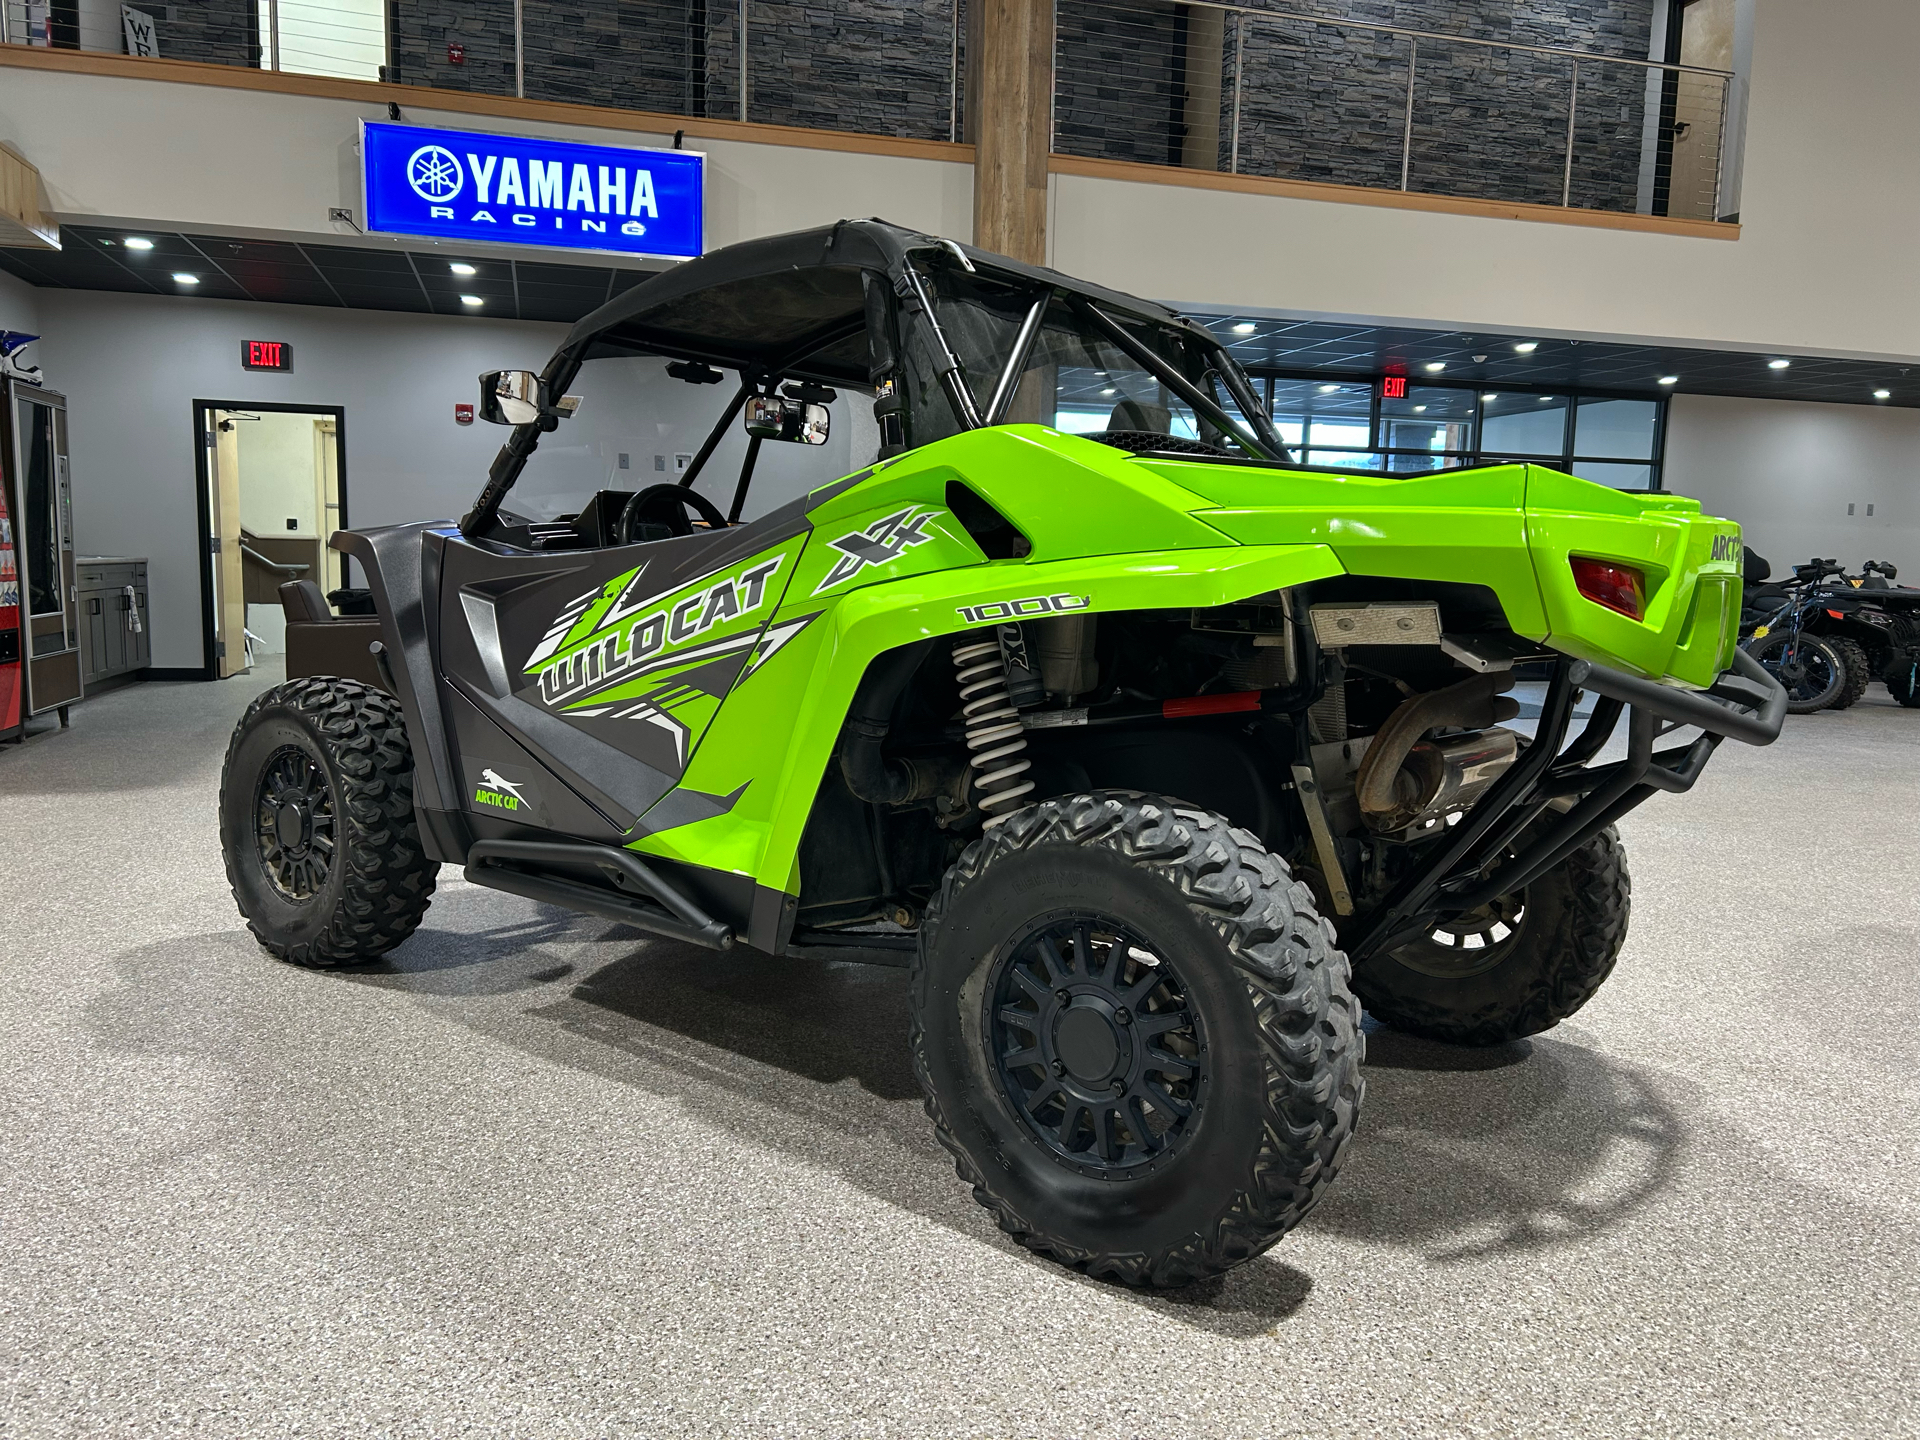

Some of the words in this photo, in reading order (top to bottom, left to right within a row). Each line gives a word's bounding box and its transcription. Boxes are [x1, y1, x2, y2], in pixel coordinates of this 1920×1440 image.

[466, 153, 659, 218] YAMAHA
[431, 205, 647, 236] RACING
[249, 341, 282, 367] EXIT
[1384, 376, 1406, 397] EXIT
[955, 592, 1091, 624] 1000
[537, 552, 787, 706] WILDCAT
[475, 789, 503, 808] ARCTIC
[503, 795, 519, 811] CAT
